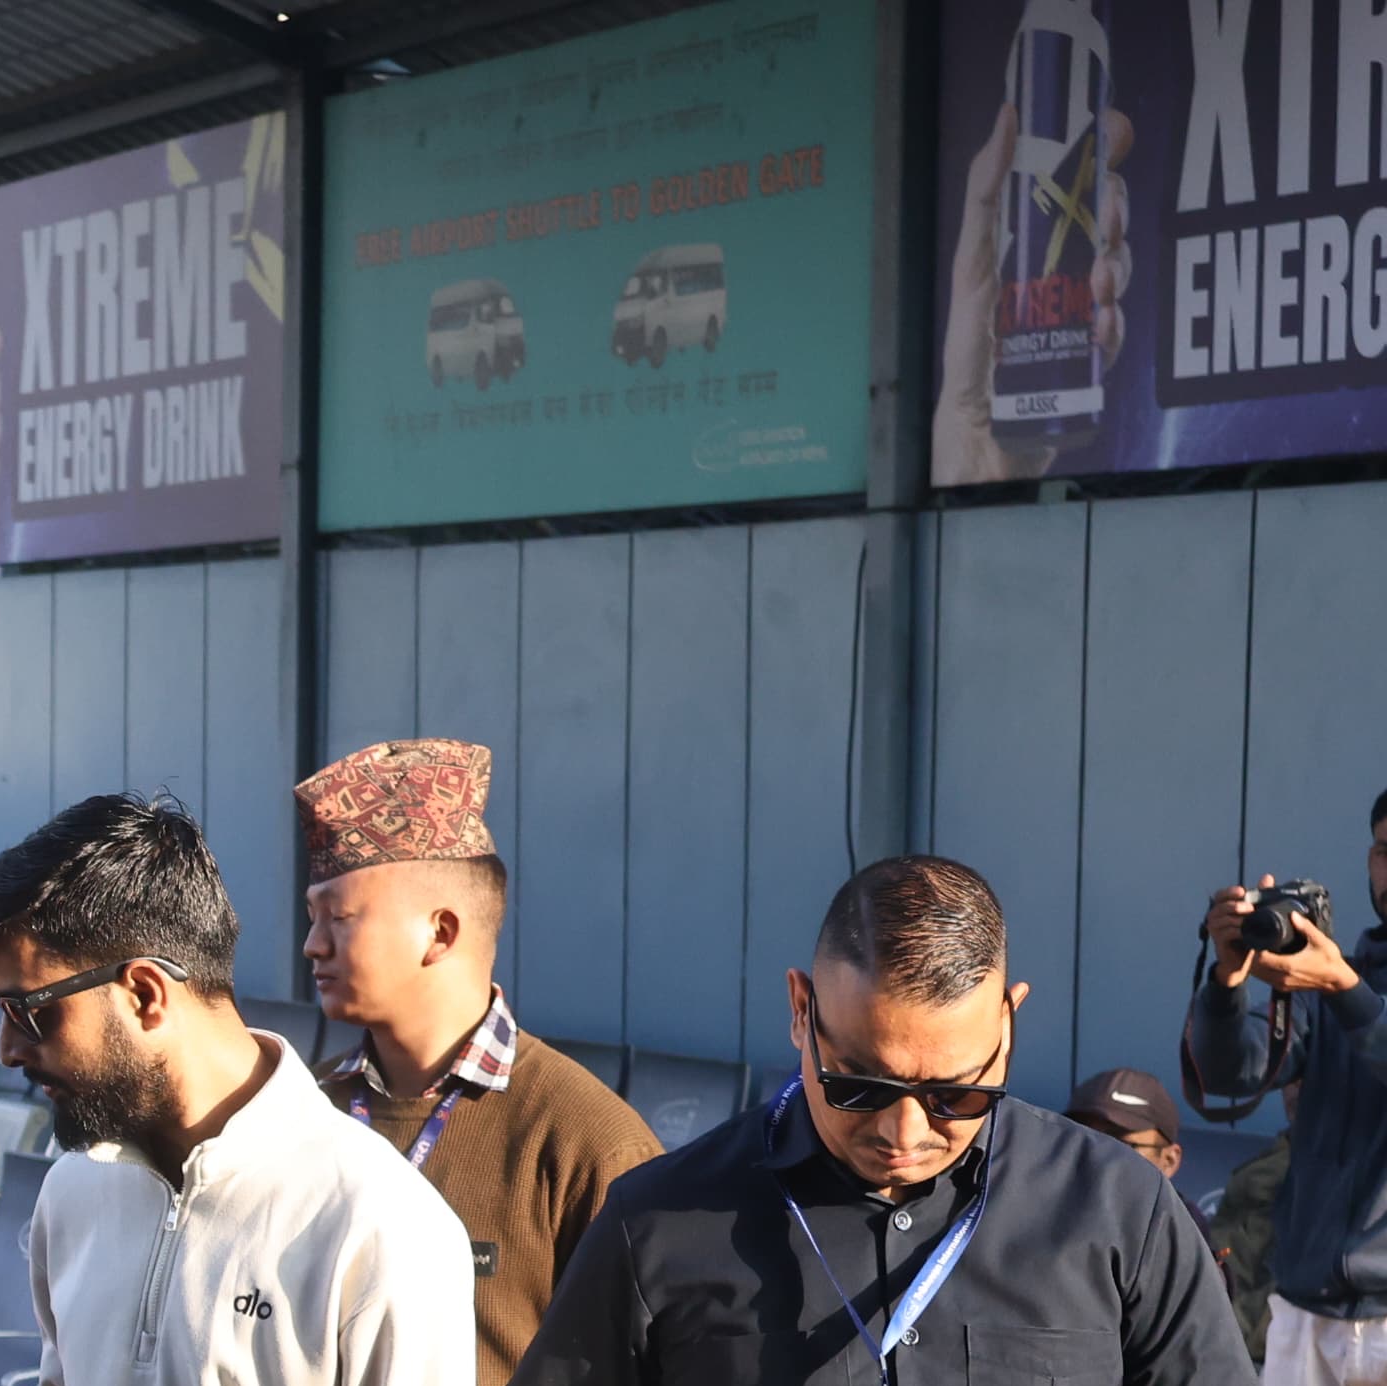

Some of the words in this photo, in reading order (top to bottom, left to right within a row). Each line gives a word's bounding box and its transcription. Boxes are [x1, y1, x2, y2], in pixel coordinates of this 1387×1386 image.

[355, 230, 402, 268] FREE
[410, 210, 499, 260] AIRPORT
[505, 188, 603, 243] SHUTTLE
[611, 180, 643, 223] TO
[650, 160, 749, 216] GOLDEN
[759, 146, 826, 195] GATE
[20, 178, 247, 394] XTREME
[17, 396, 134, 504] ENERGY
[143, 376, 245, 489] DRINK
[1016, 394, 1059, 416] CLASSIC
[233, 1288, 273, 1321] alo
